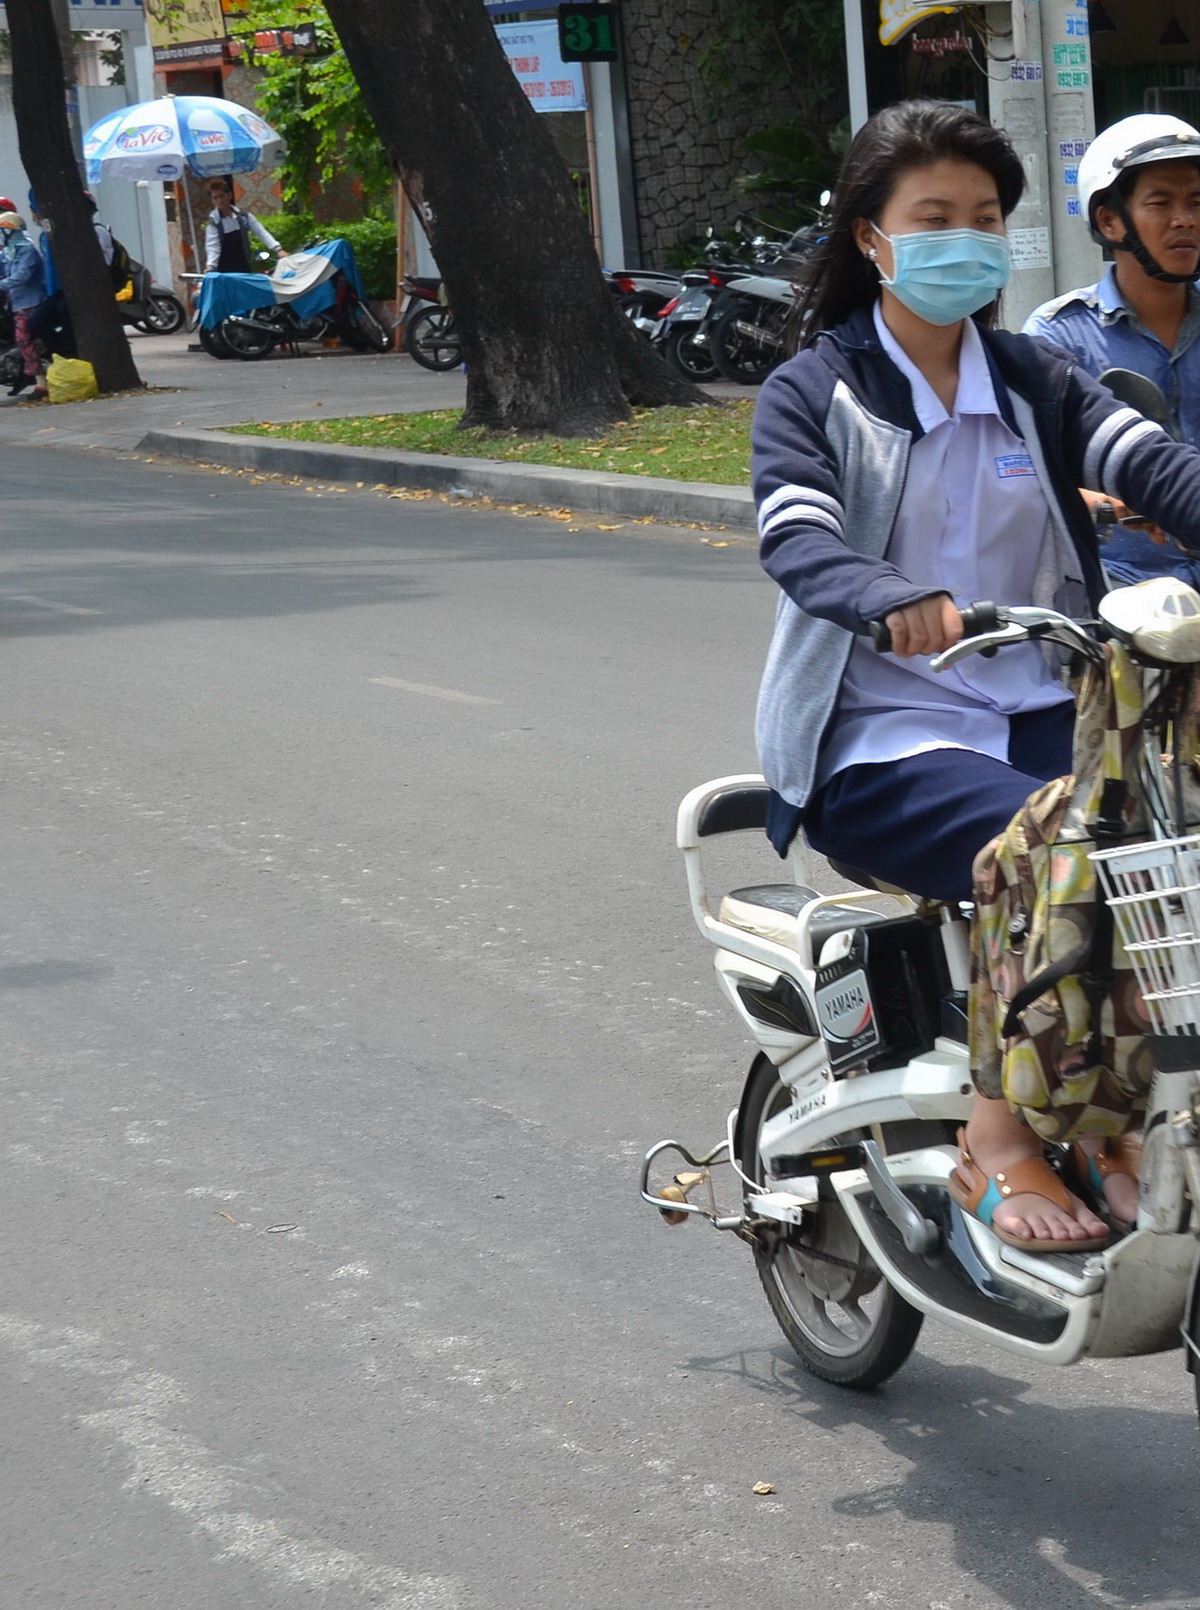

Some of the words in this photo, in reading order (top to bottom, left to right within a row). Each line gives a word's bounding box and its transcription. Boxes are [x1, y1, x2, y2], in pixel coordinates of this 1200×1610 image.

[565, 15, 617, 52] 31
[824, 986, 866, 1022] YAMAHA
[788, 1095, 827, 1125] YAMAHA
